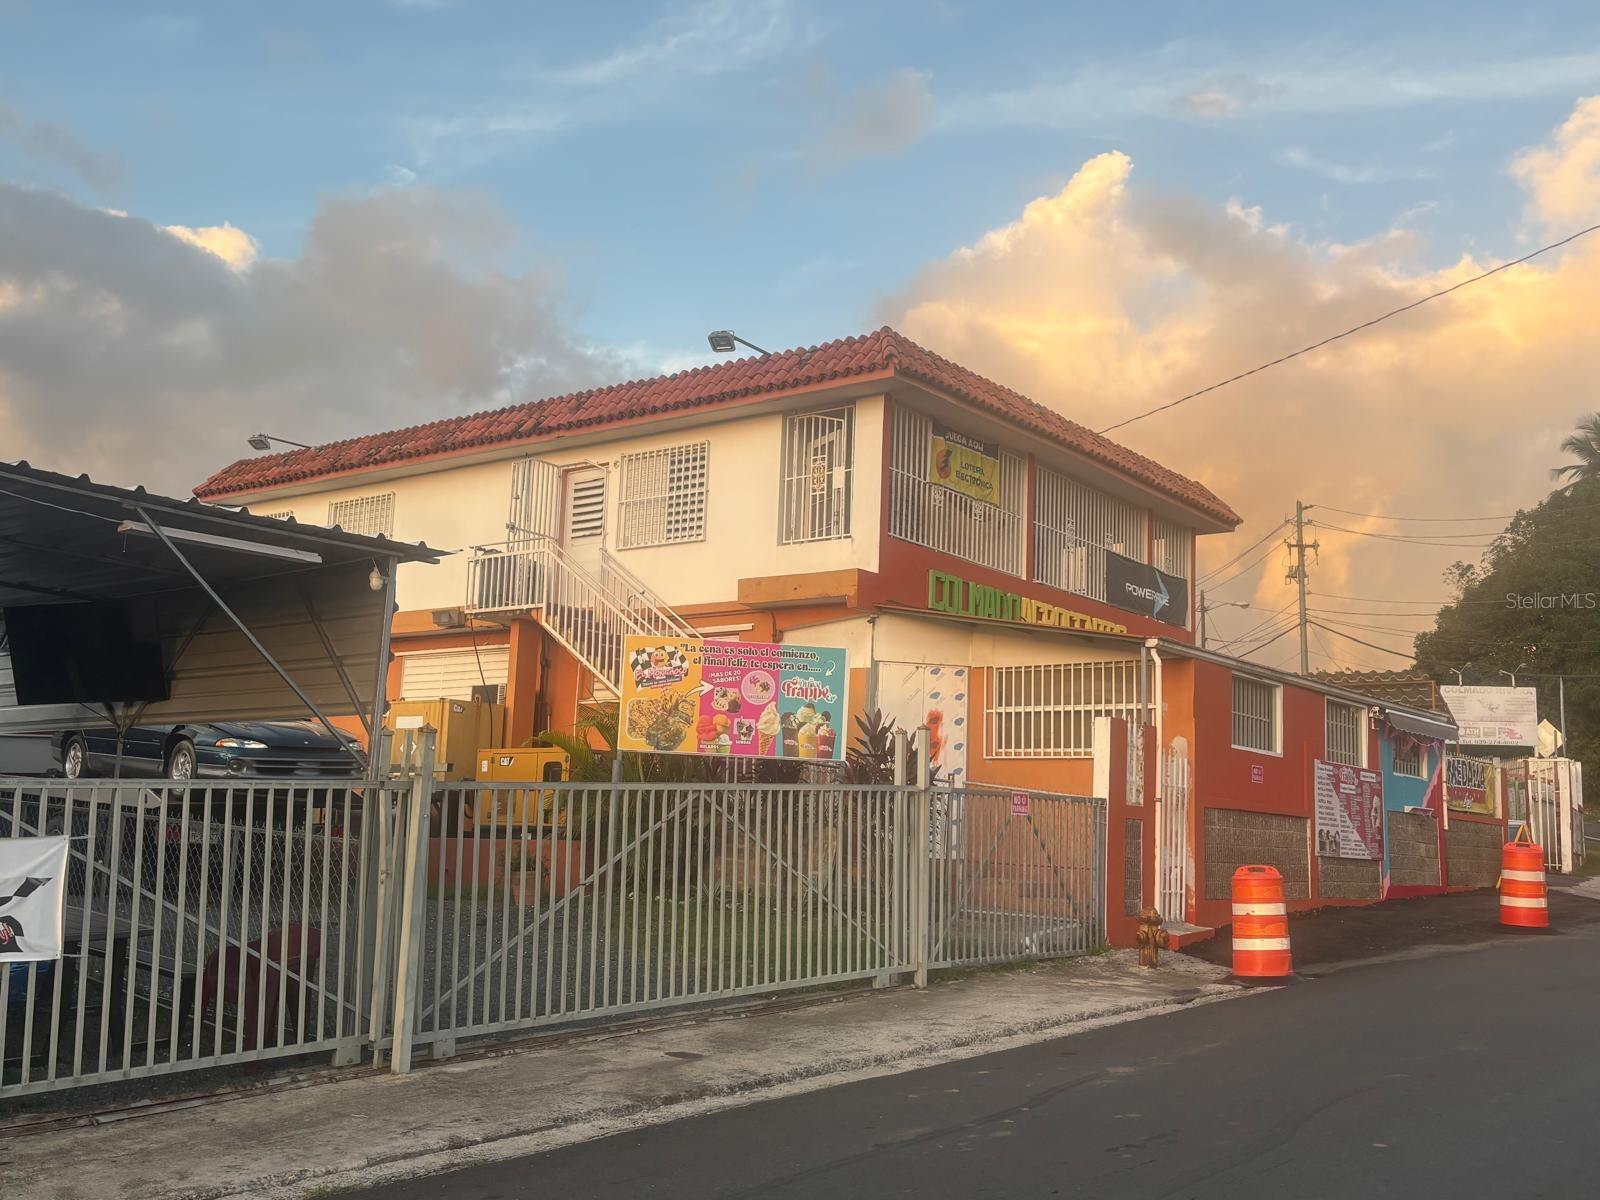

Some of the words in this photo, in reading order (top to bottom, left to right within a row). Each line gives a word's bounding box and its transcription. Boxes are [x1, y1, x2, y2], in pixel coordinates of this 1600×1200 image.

[927, 569, 1021, 621] COLMADO
[699, 645, 721, 654] cena
[724, 647, 735, 655] es
[737, 647, 758, 656] solo
[760, 648, 769, 657] el
[771, 649, 819, 661] comienzo,
[693, 656, 702, 665] el
[704, 656, 726, 666] final
[728, 657, 748, 667] feliz
[750, 660, 761, 668] te
[762, 662, 795, 671] espera
[500, 757, 510, 766] CAT
